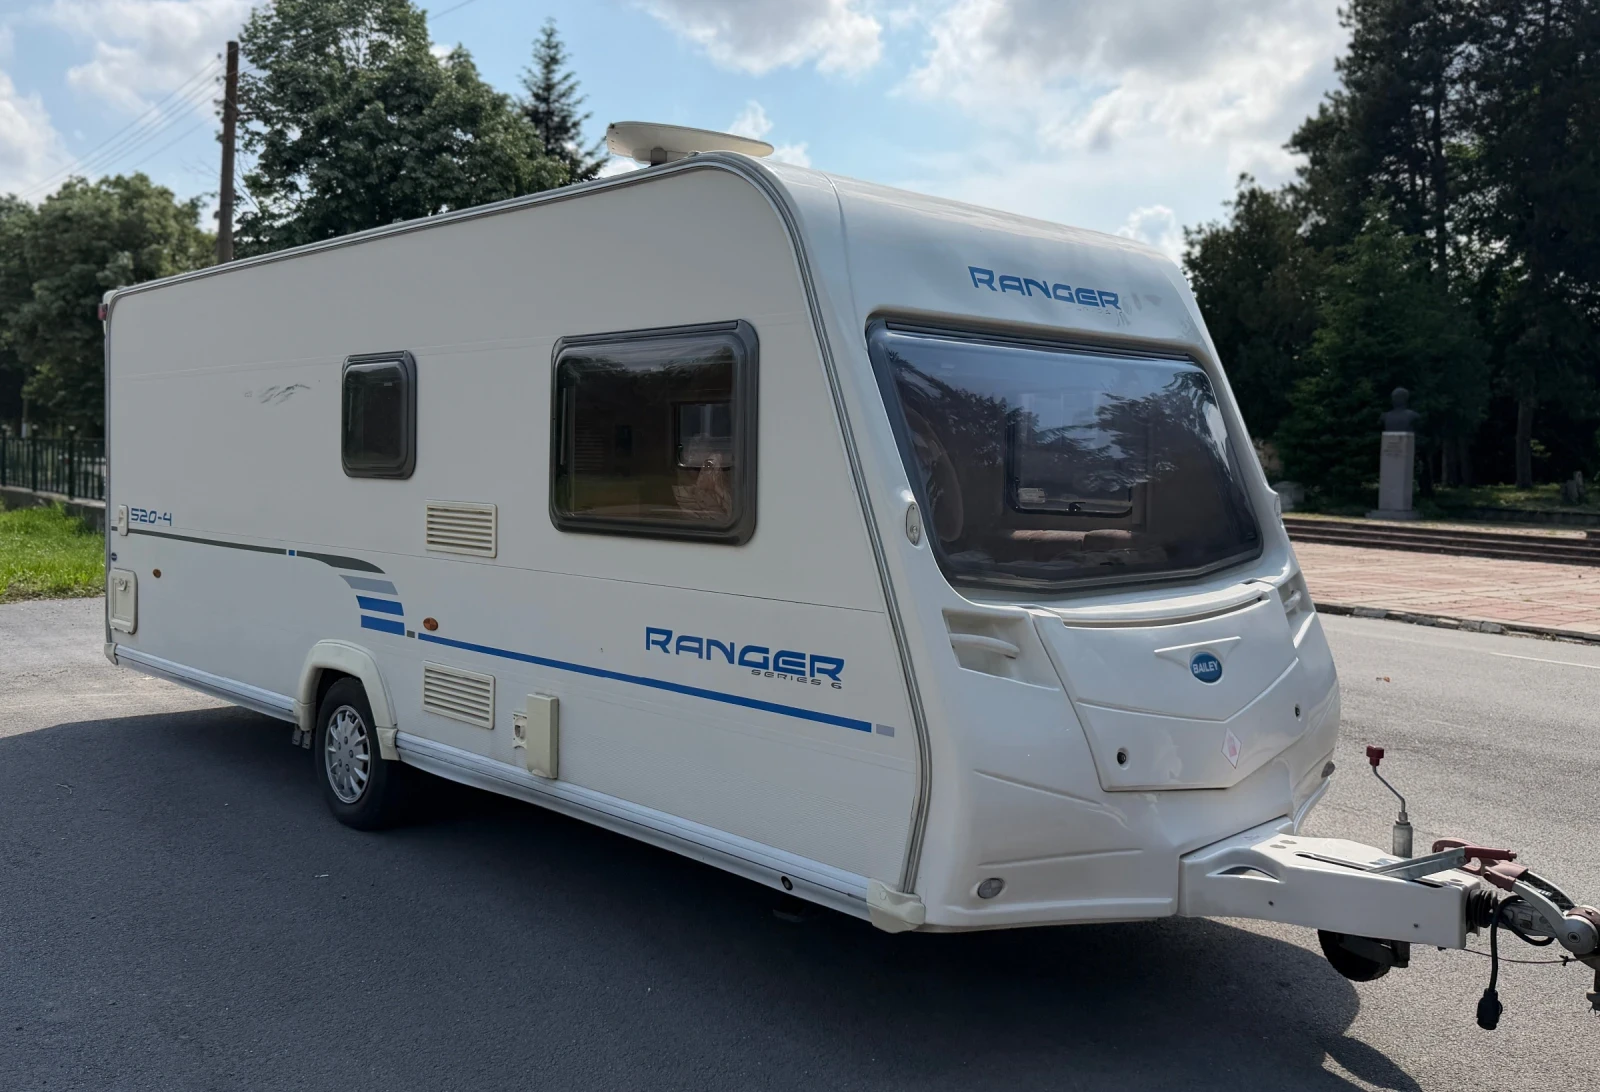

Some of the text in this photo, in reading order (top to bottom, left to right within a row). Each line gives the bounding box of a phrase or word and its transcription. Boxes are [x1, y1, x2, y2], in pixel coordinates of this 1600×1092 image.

[968, 266, 1121, 309] RANGER
[131, 507, 172, 526] 520-4
[645, 626, 845, 681] RANGER
[1193, 660, 1218, 674] BAILEY
[751, 669, 842, 690] SERIES 6
